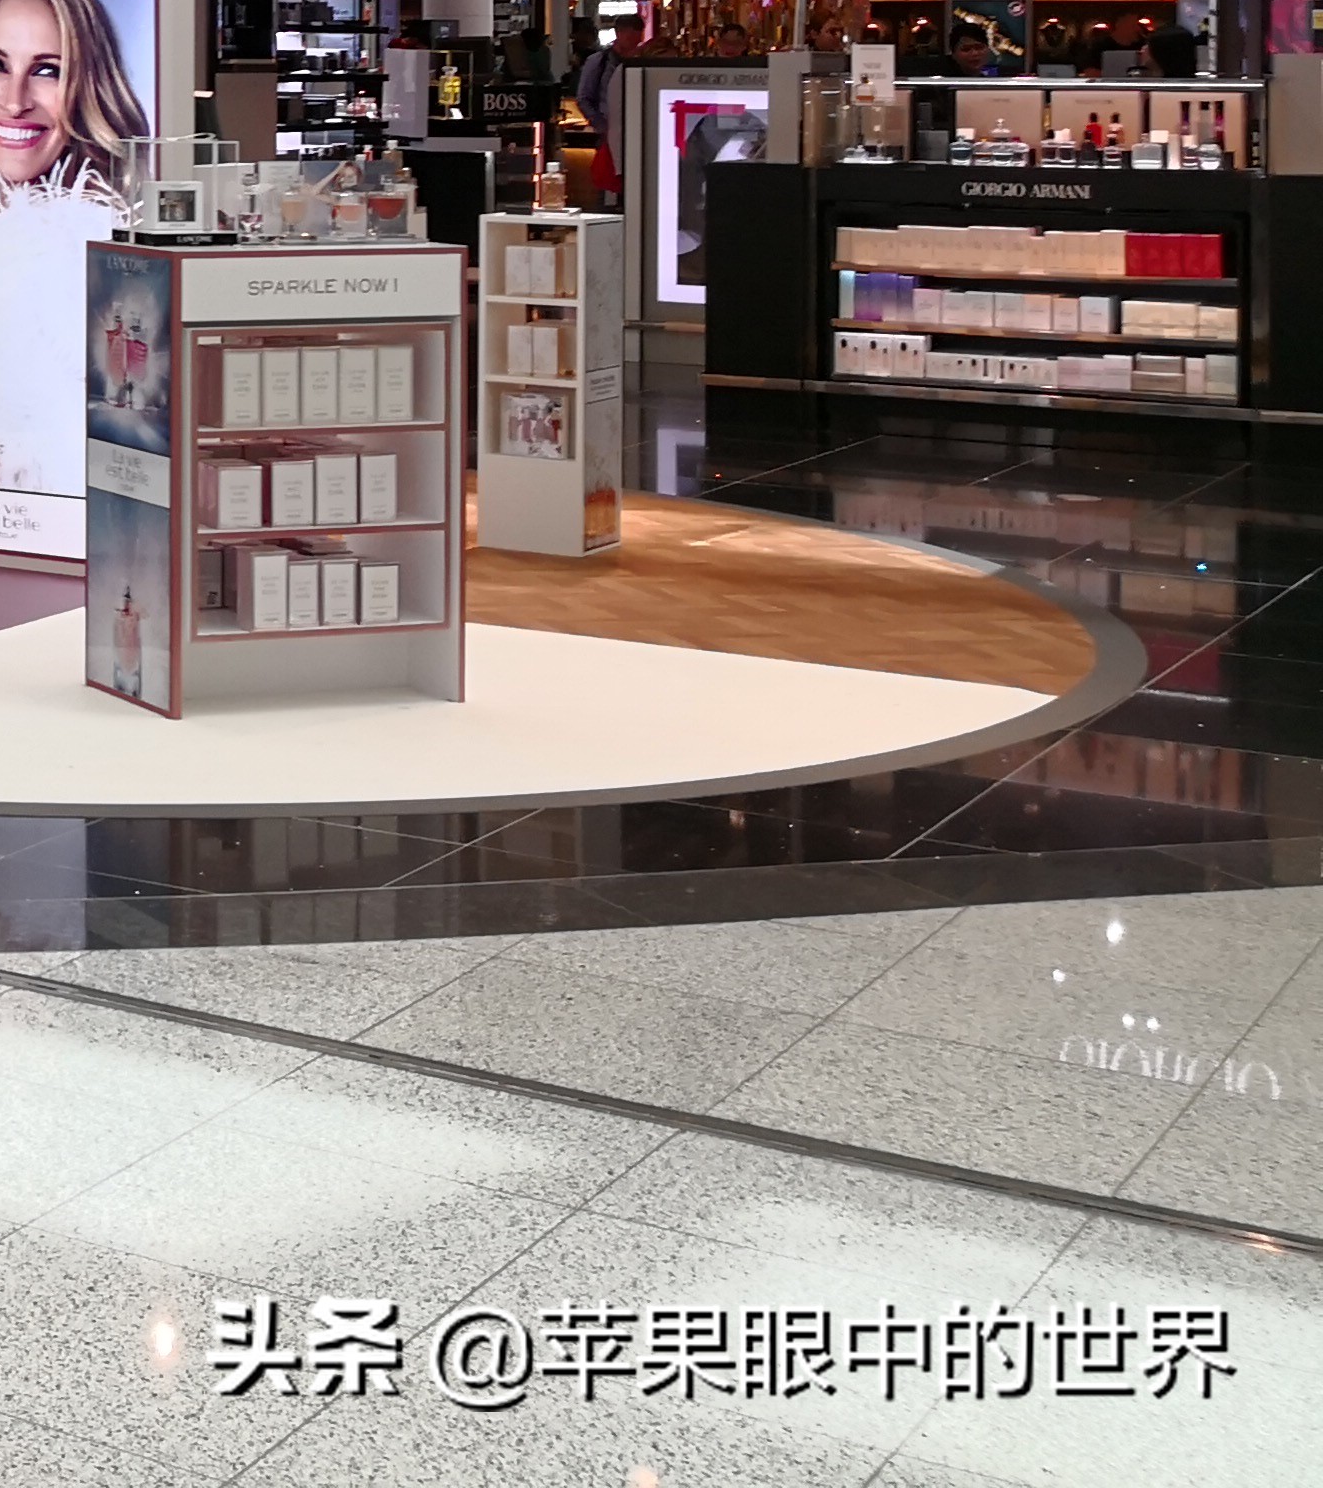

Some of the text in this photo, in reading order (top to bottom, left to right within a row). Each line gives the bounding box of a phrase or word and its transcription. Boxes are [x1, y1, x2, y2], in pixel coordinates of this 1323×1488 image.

[482, 92, 528, 111] BOSS
[960, 181, 1092, 200] GIORGIO ARMANI
[247, 278, 338, 296] SPARKLE
[343, 278, 388, 294] NOW
[3, 502, 29, 516] vie
[2, 514, 41, 532] belle
